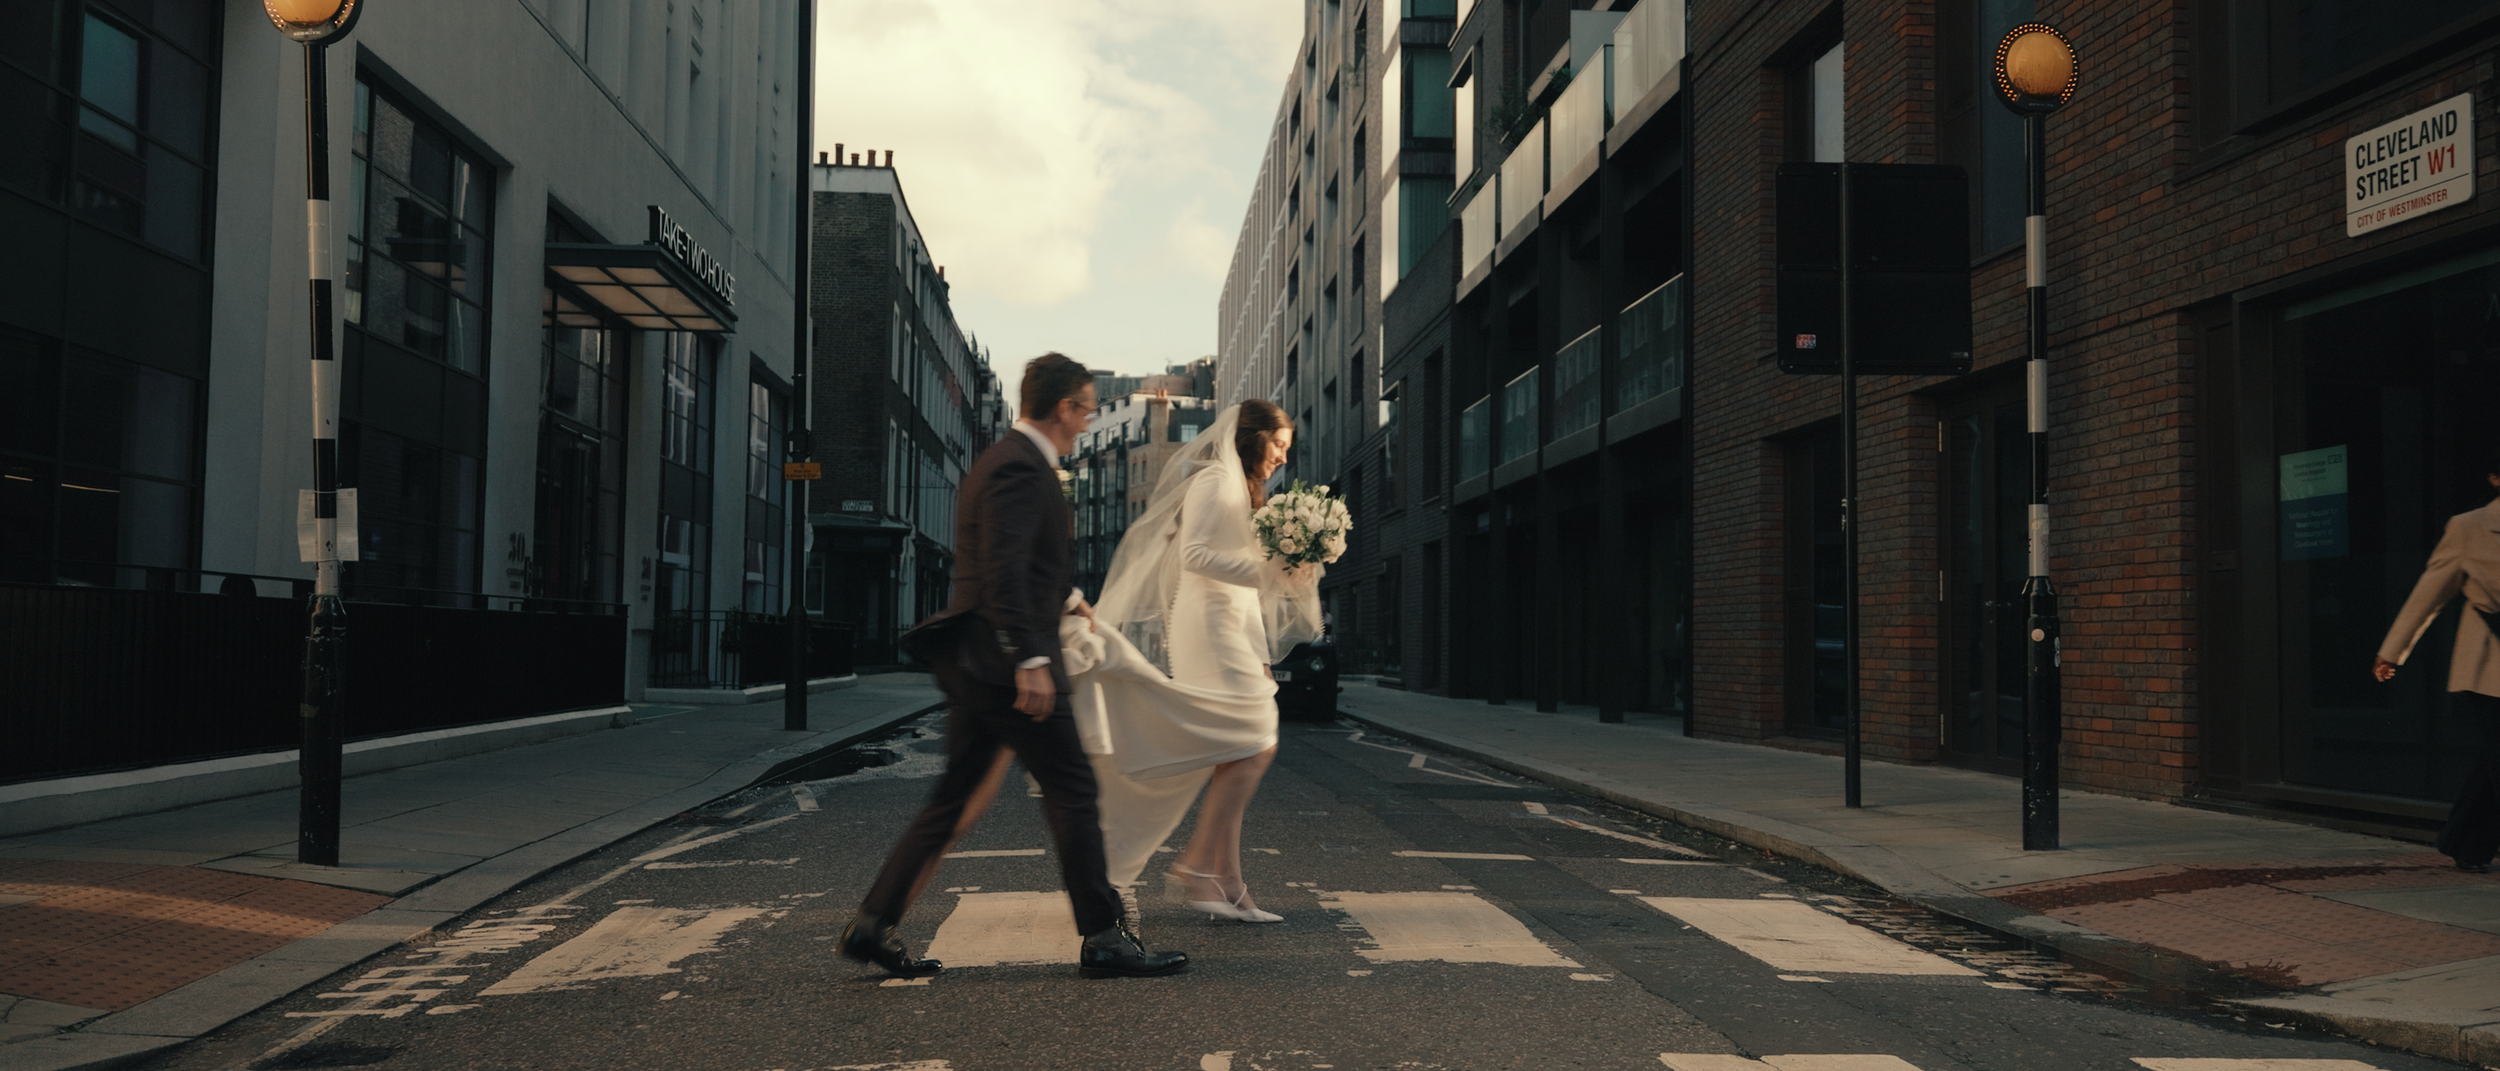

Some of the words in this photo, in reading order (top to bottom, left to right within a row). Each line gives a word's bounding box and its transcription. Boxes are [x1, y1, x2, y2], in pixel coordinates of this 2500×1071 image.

[2356, 109, 2458, 170] CLEVELAND
[2356, 155, 2421, 201] STREET
[2427, 143, 2455, 176] W1
[2357, 212, 2374, 228] CITY
[2376, 208, 2386, 222] OF
[2388, 188, 2448, 218] WESTMINSTER
[658, 205, 707, 280] TAKE-TWO
[708, 254, 735, 306] HOUSE
[508, 531, 525, 563] 30
[406, 914, 575, 959] LOOK
[284, 963, 491, 1019] LEFT
